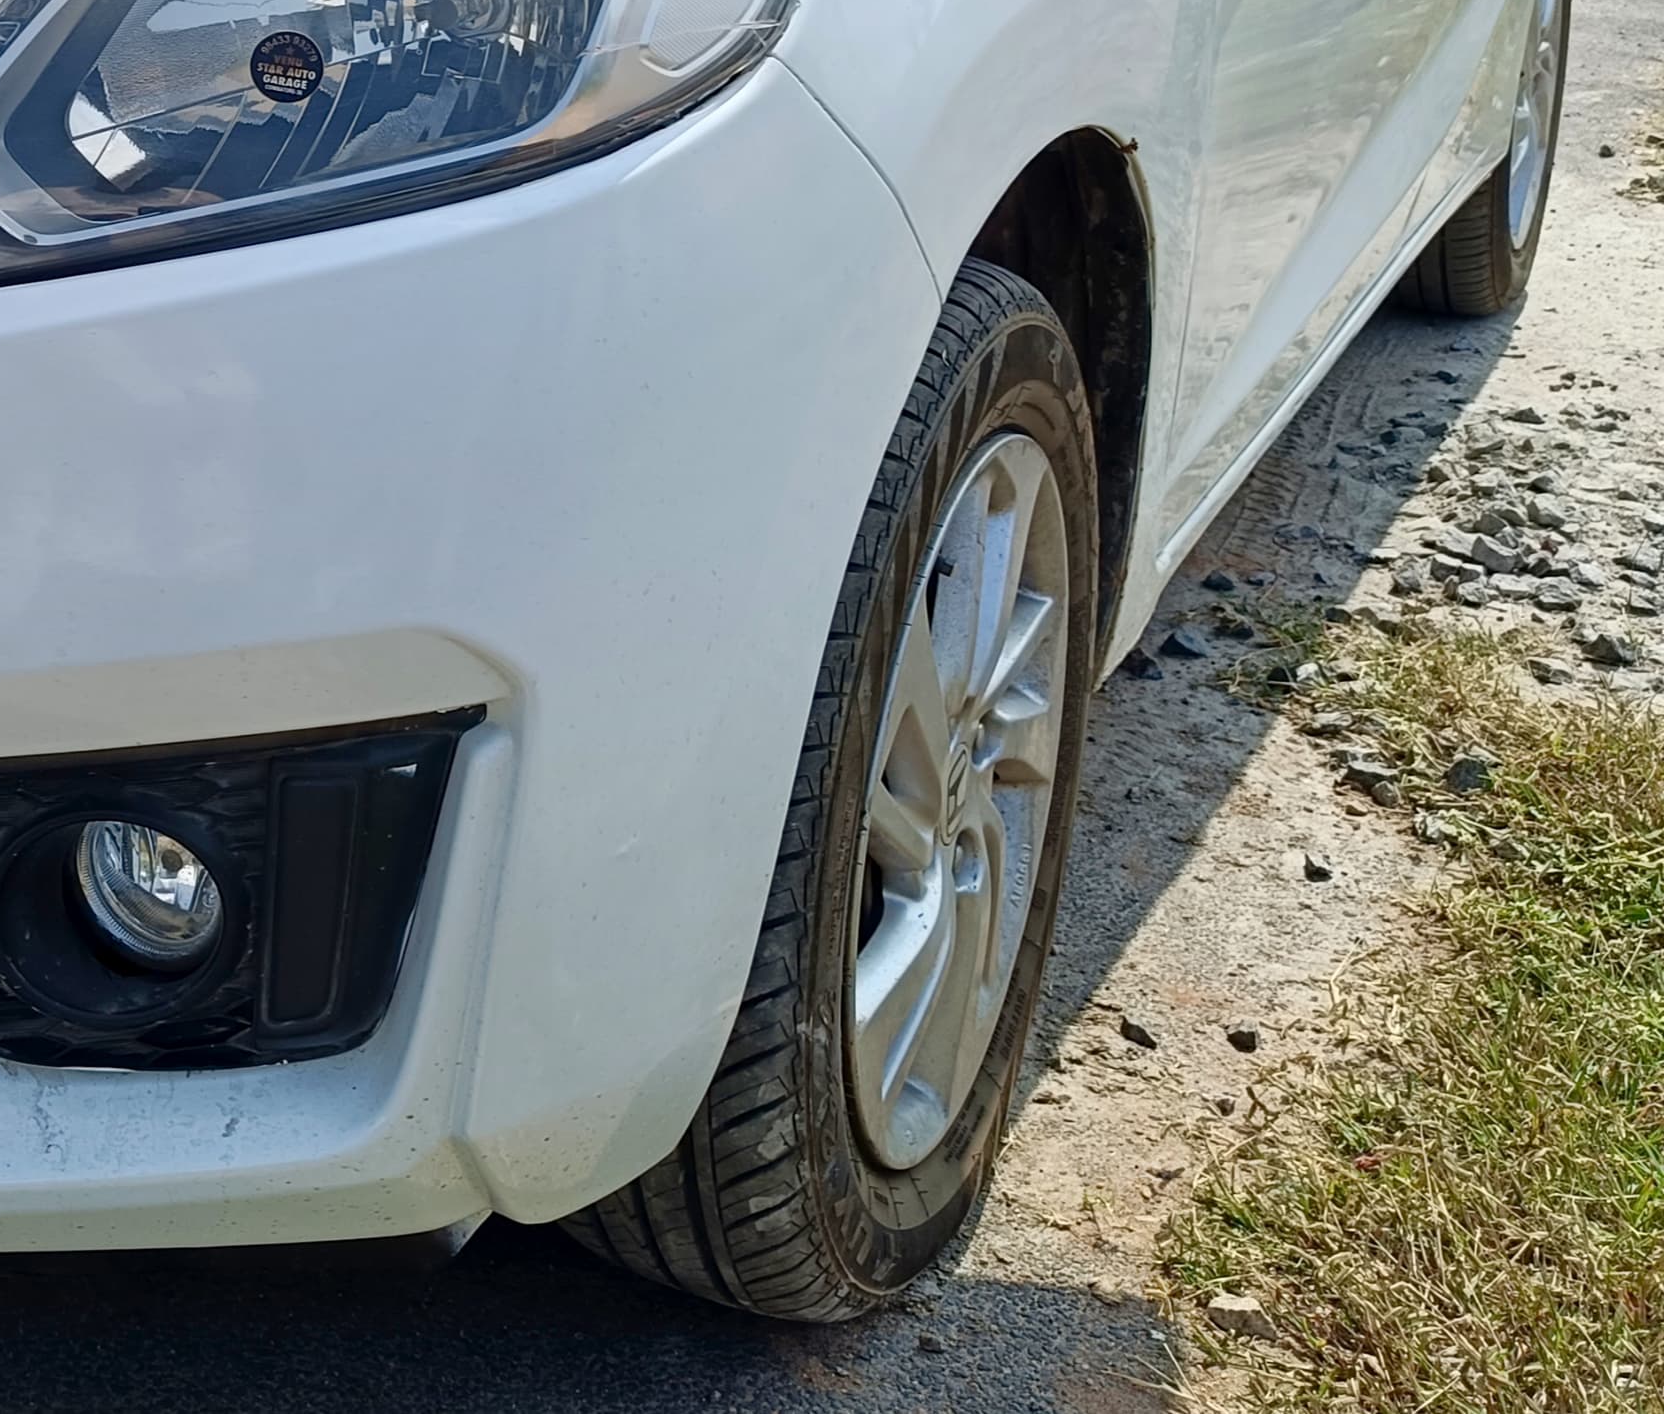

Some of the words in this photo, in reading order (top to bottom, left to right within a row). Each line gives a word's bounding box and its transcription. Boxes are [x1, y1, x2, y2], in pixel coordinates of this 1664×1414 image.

[257, 62, 284, 76] STAR
[287, 67, 316, 80] AUTO
[263, 74, 308, 90] GARAGE
